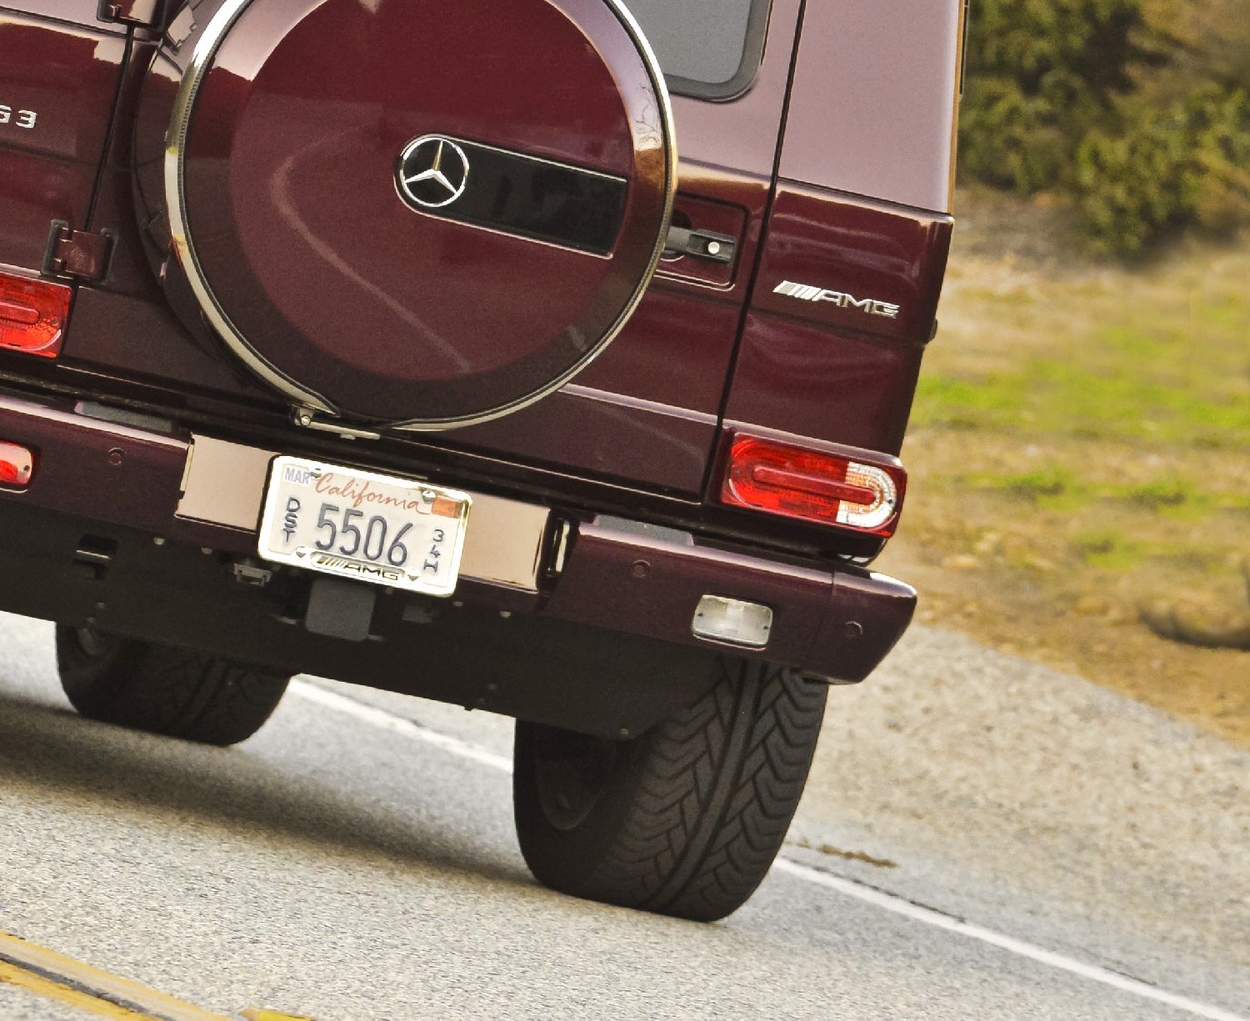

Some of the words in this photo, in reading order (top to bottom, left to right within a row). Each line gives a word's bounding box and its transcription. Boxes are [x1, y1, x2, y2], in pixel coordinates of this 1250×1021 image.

[284, 467, 311, 485] MAR
[314, 472, 430, 515] California
[314, 502, 414, 566] 5506
